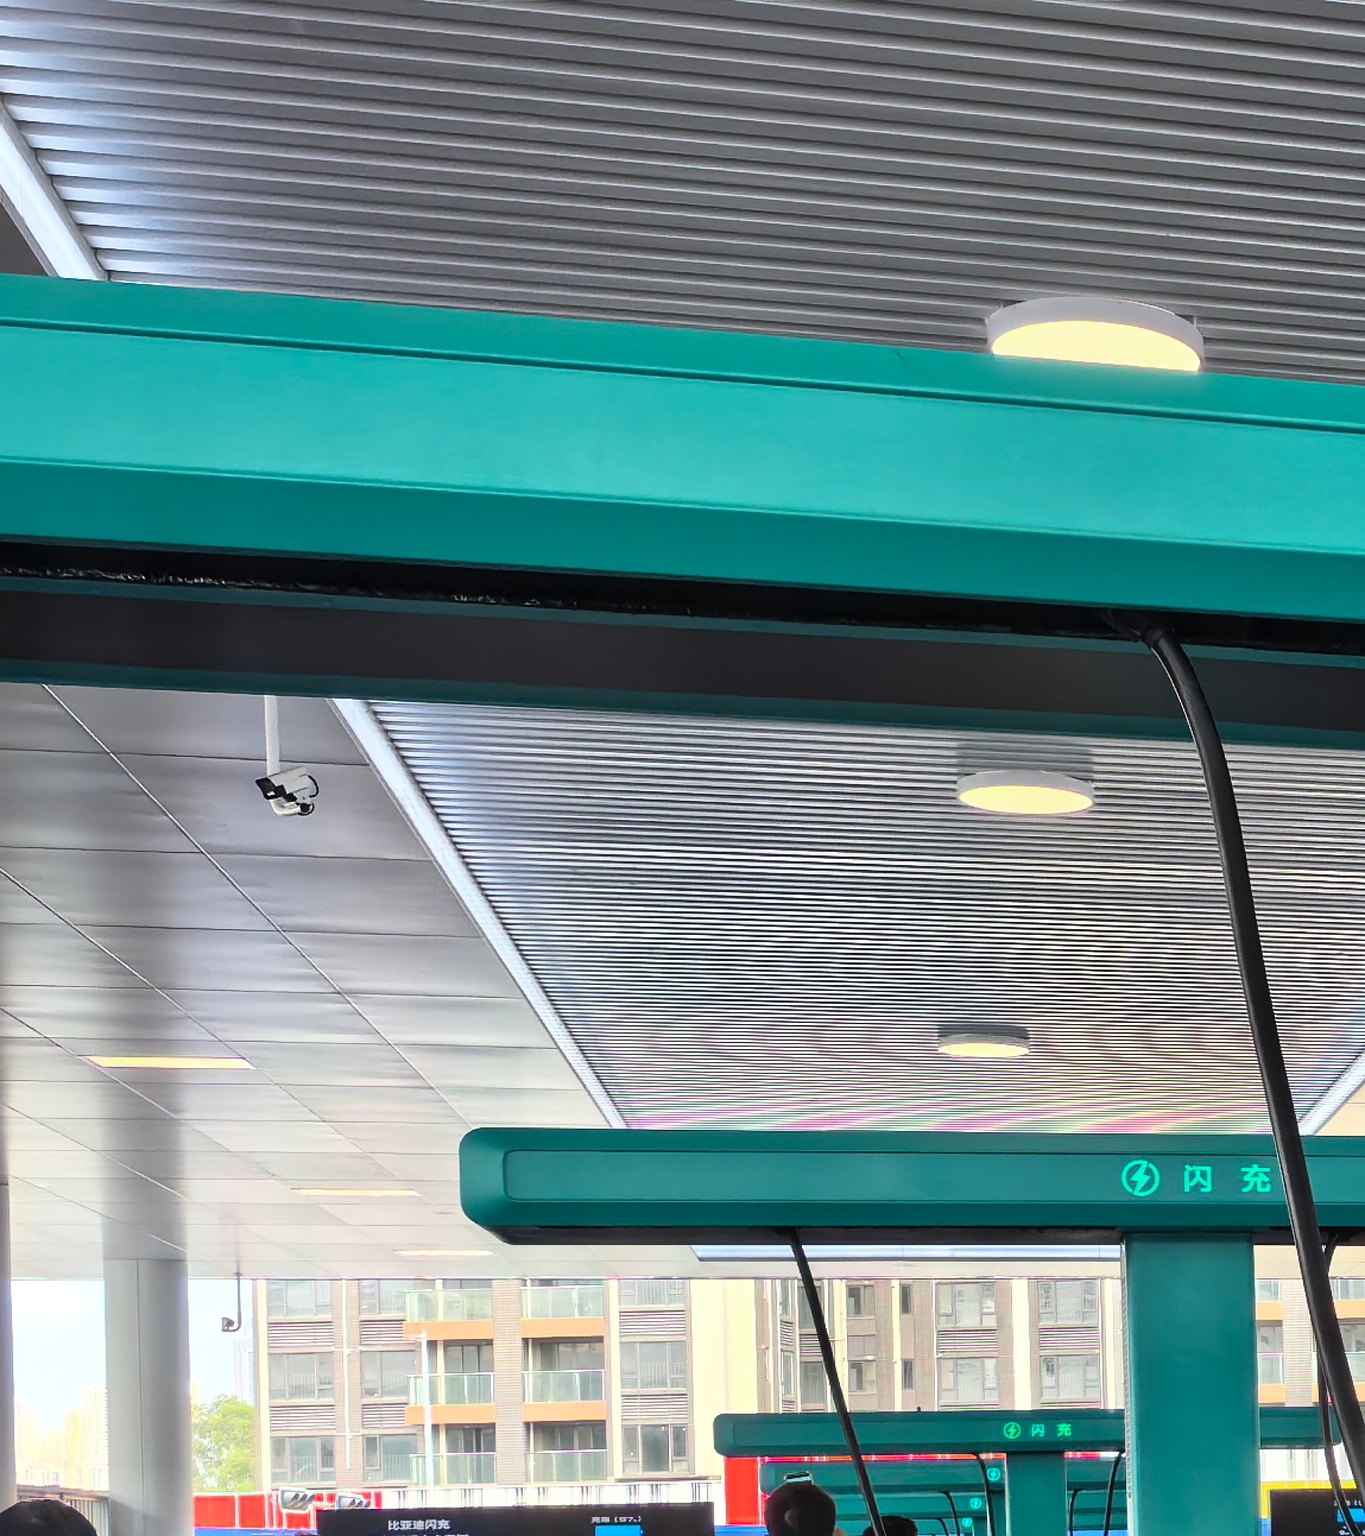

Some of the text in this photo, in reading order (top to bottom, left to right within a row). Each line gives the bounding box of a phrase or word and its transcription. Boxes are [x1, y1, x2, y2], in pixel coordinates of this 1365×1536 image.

[1183, 1163, 1272, 1193] 闪充
[1031, 1423, 1072, 1438] 闪充
[388, 1518, 451, 1531] 比亚迪闪充
